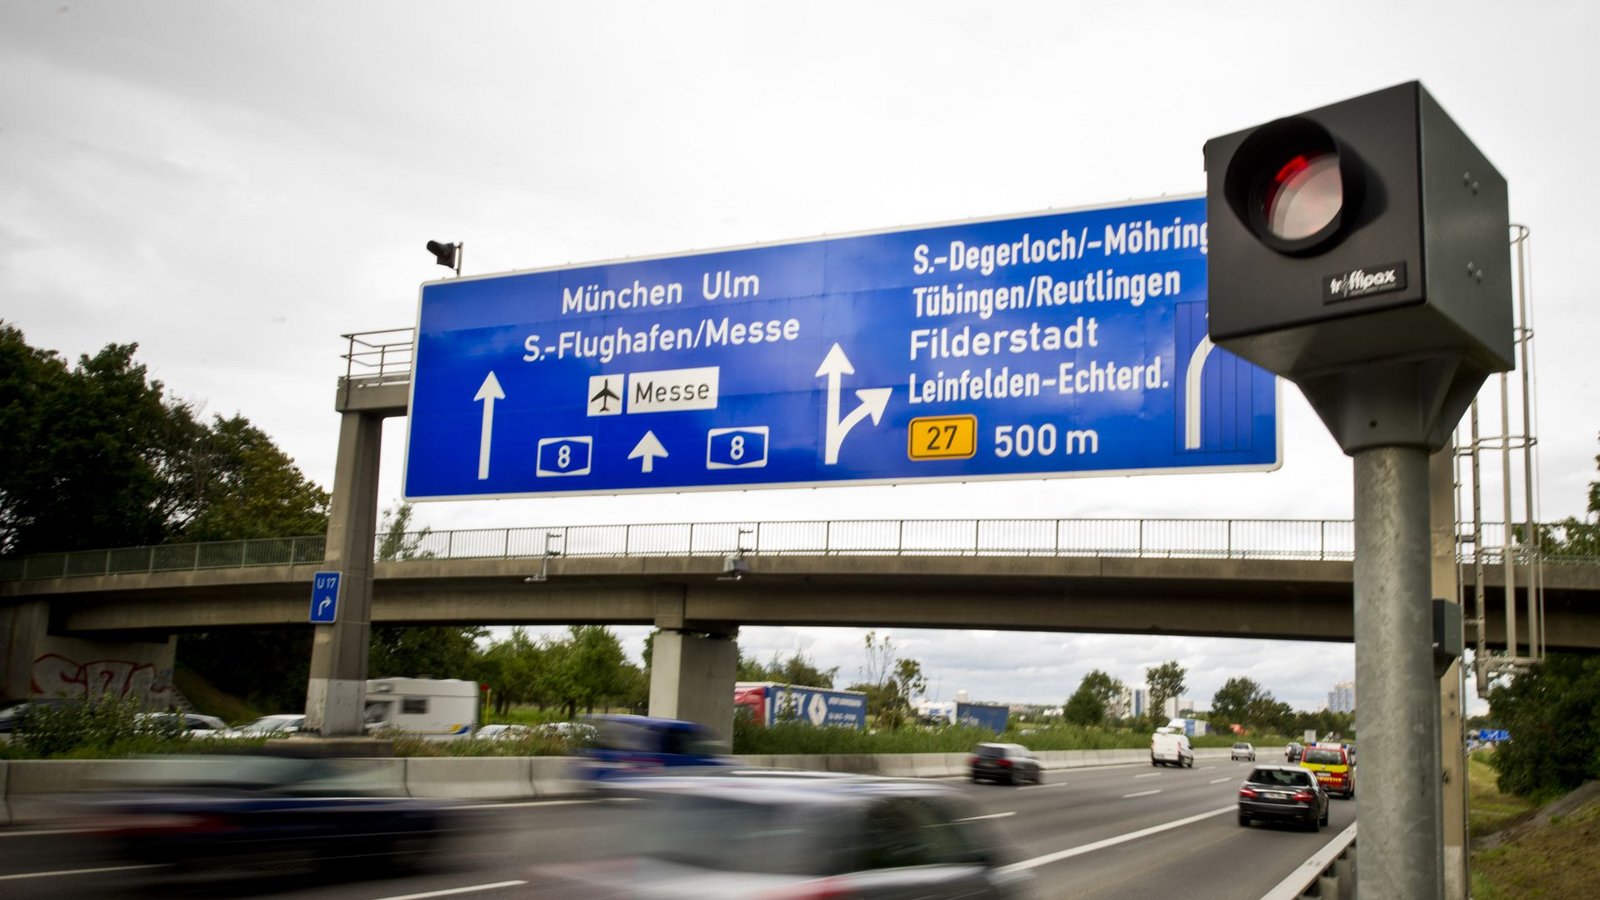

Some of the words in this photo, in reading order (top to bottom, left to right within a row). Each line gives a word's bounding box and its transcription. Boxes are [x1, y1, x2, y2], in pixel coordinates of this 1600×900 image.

[561, 279, 683, 315] München
[702, 269, 761, 301] Ulm
[912, 270, 1181, 321] Tübingen/Reutlingen
[523, 316, 801, 364] S.-Flughafen/Messe
[910, 316, 1099, 361] Filderstadt
[635, 381, 710, 404] Messe
[908, 356, 1170, 404] Leinfelden-Echterd.
[730, 435, 745, 460] 8
[927, 425, 958, 451] 27
[994, 423, 1057, 458] 500
[1066, 429, 1099, 455] m
[557, 445, 571, 468] 8
[317, 577, 326, 589] U
[326, 577, 337, 589] 17
